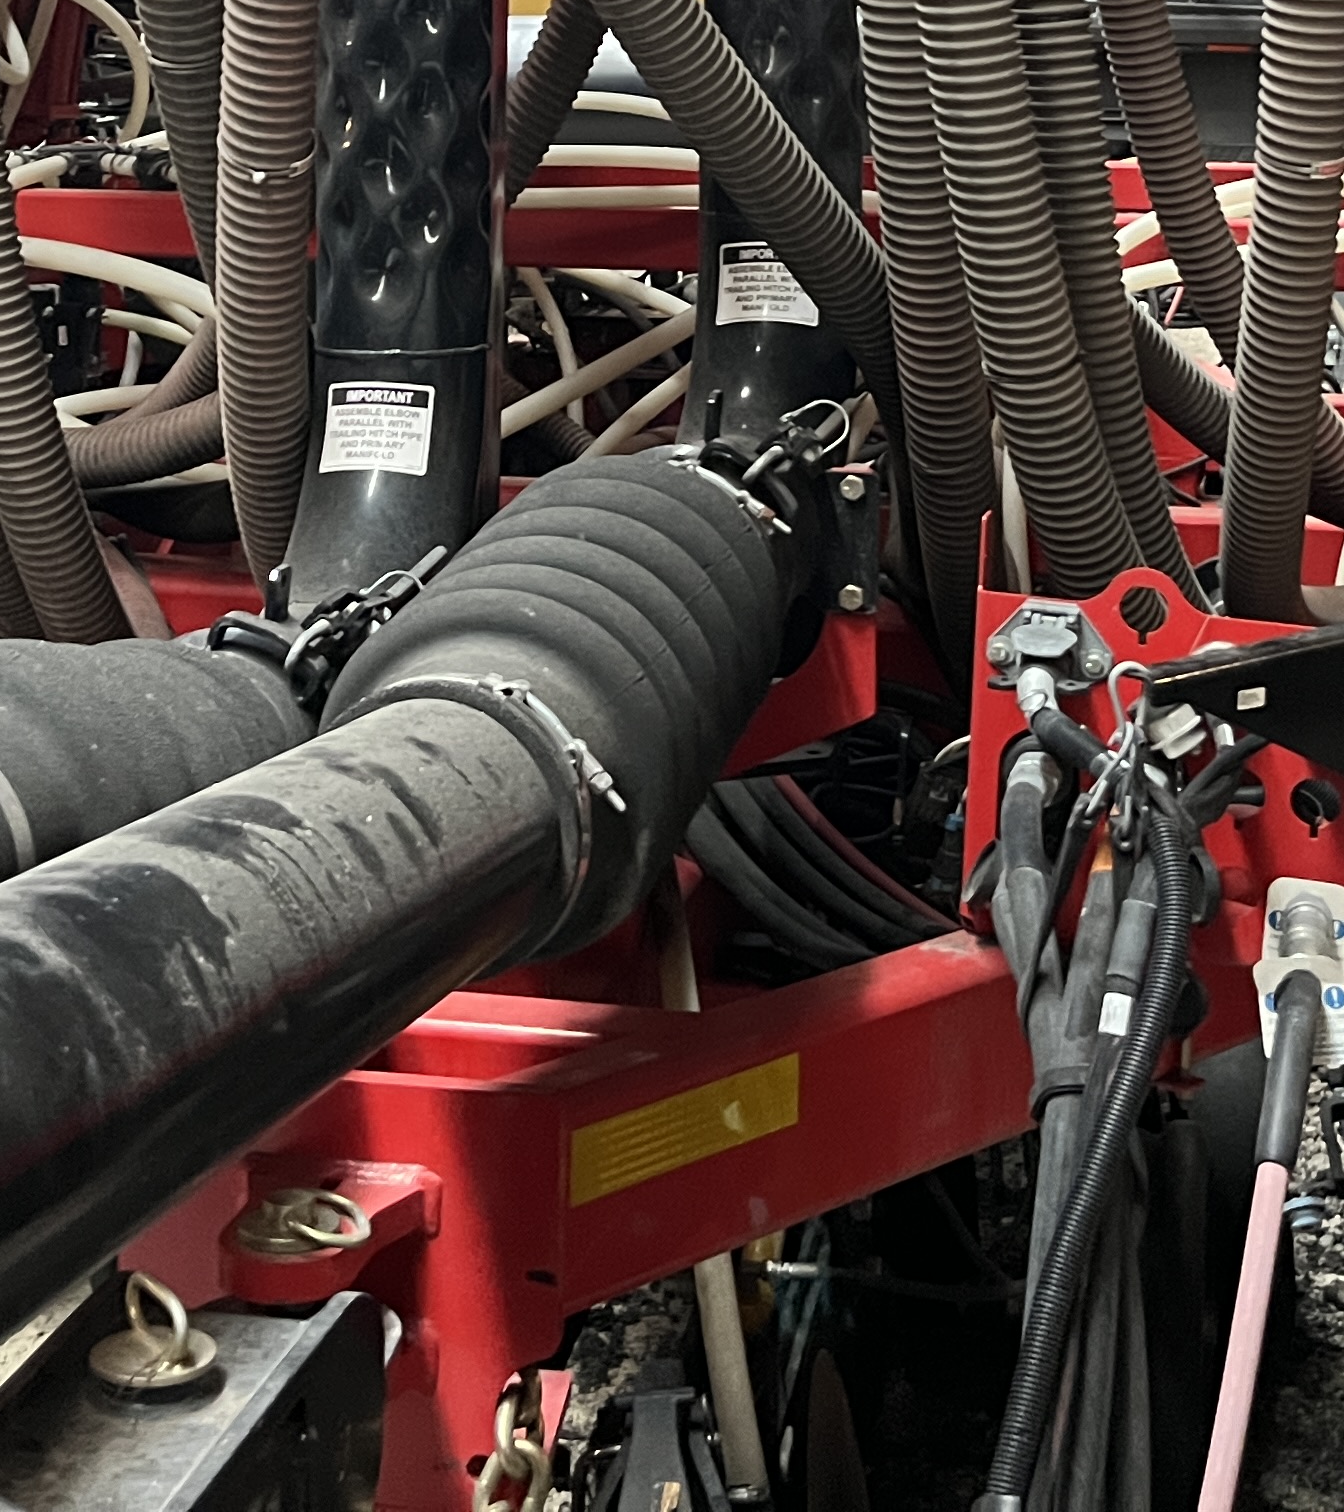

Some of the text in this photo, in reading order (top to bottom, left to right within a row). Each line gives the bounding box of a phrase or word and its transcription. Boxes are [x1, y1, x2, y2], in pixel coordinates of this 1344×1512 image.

[739, 248, 775, 260] IMPOR
[346, 389, 414, 404] IMPORTANT
[335, 407, 420, 418] ASSEMBLE ELBOW
[339, 418, 412, 429] PARALLEL WITH
[369, 429, 398, 438] HITCH
[401, 431, 423, 441] PIPE
[340, 439, 358, 448] AND
